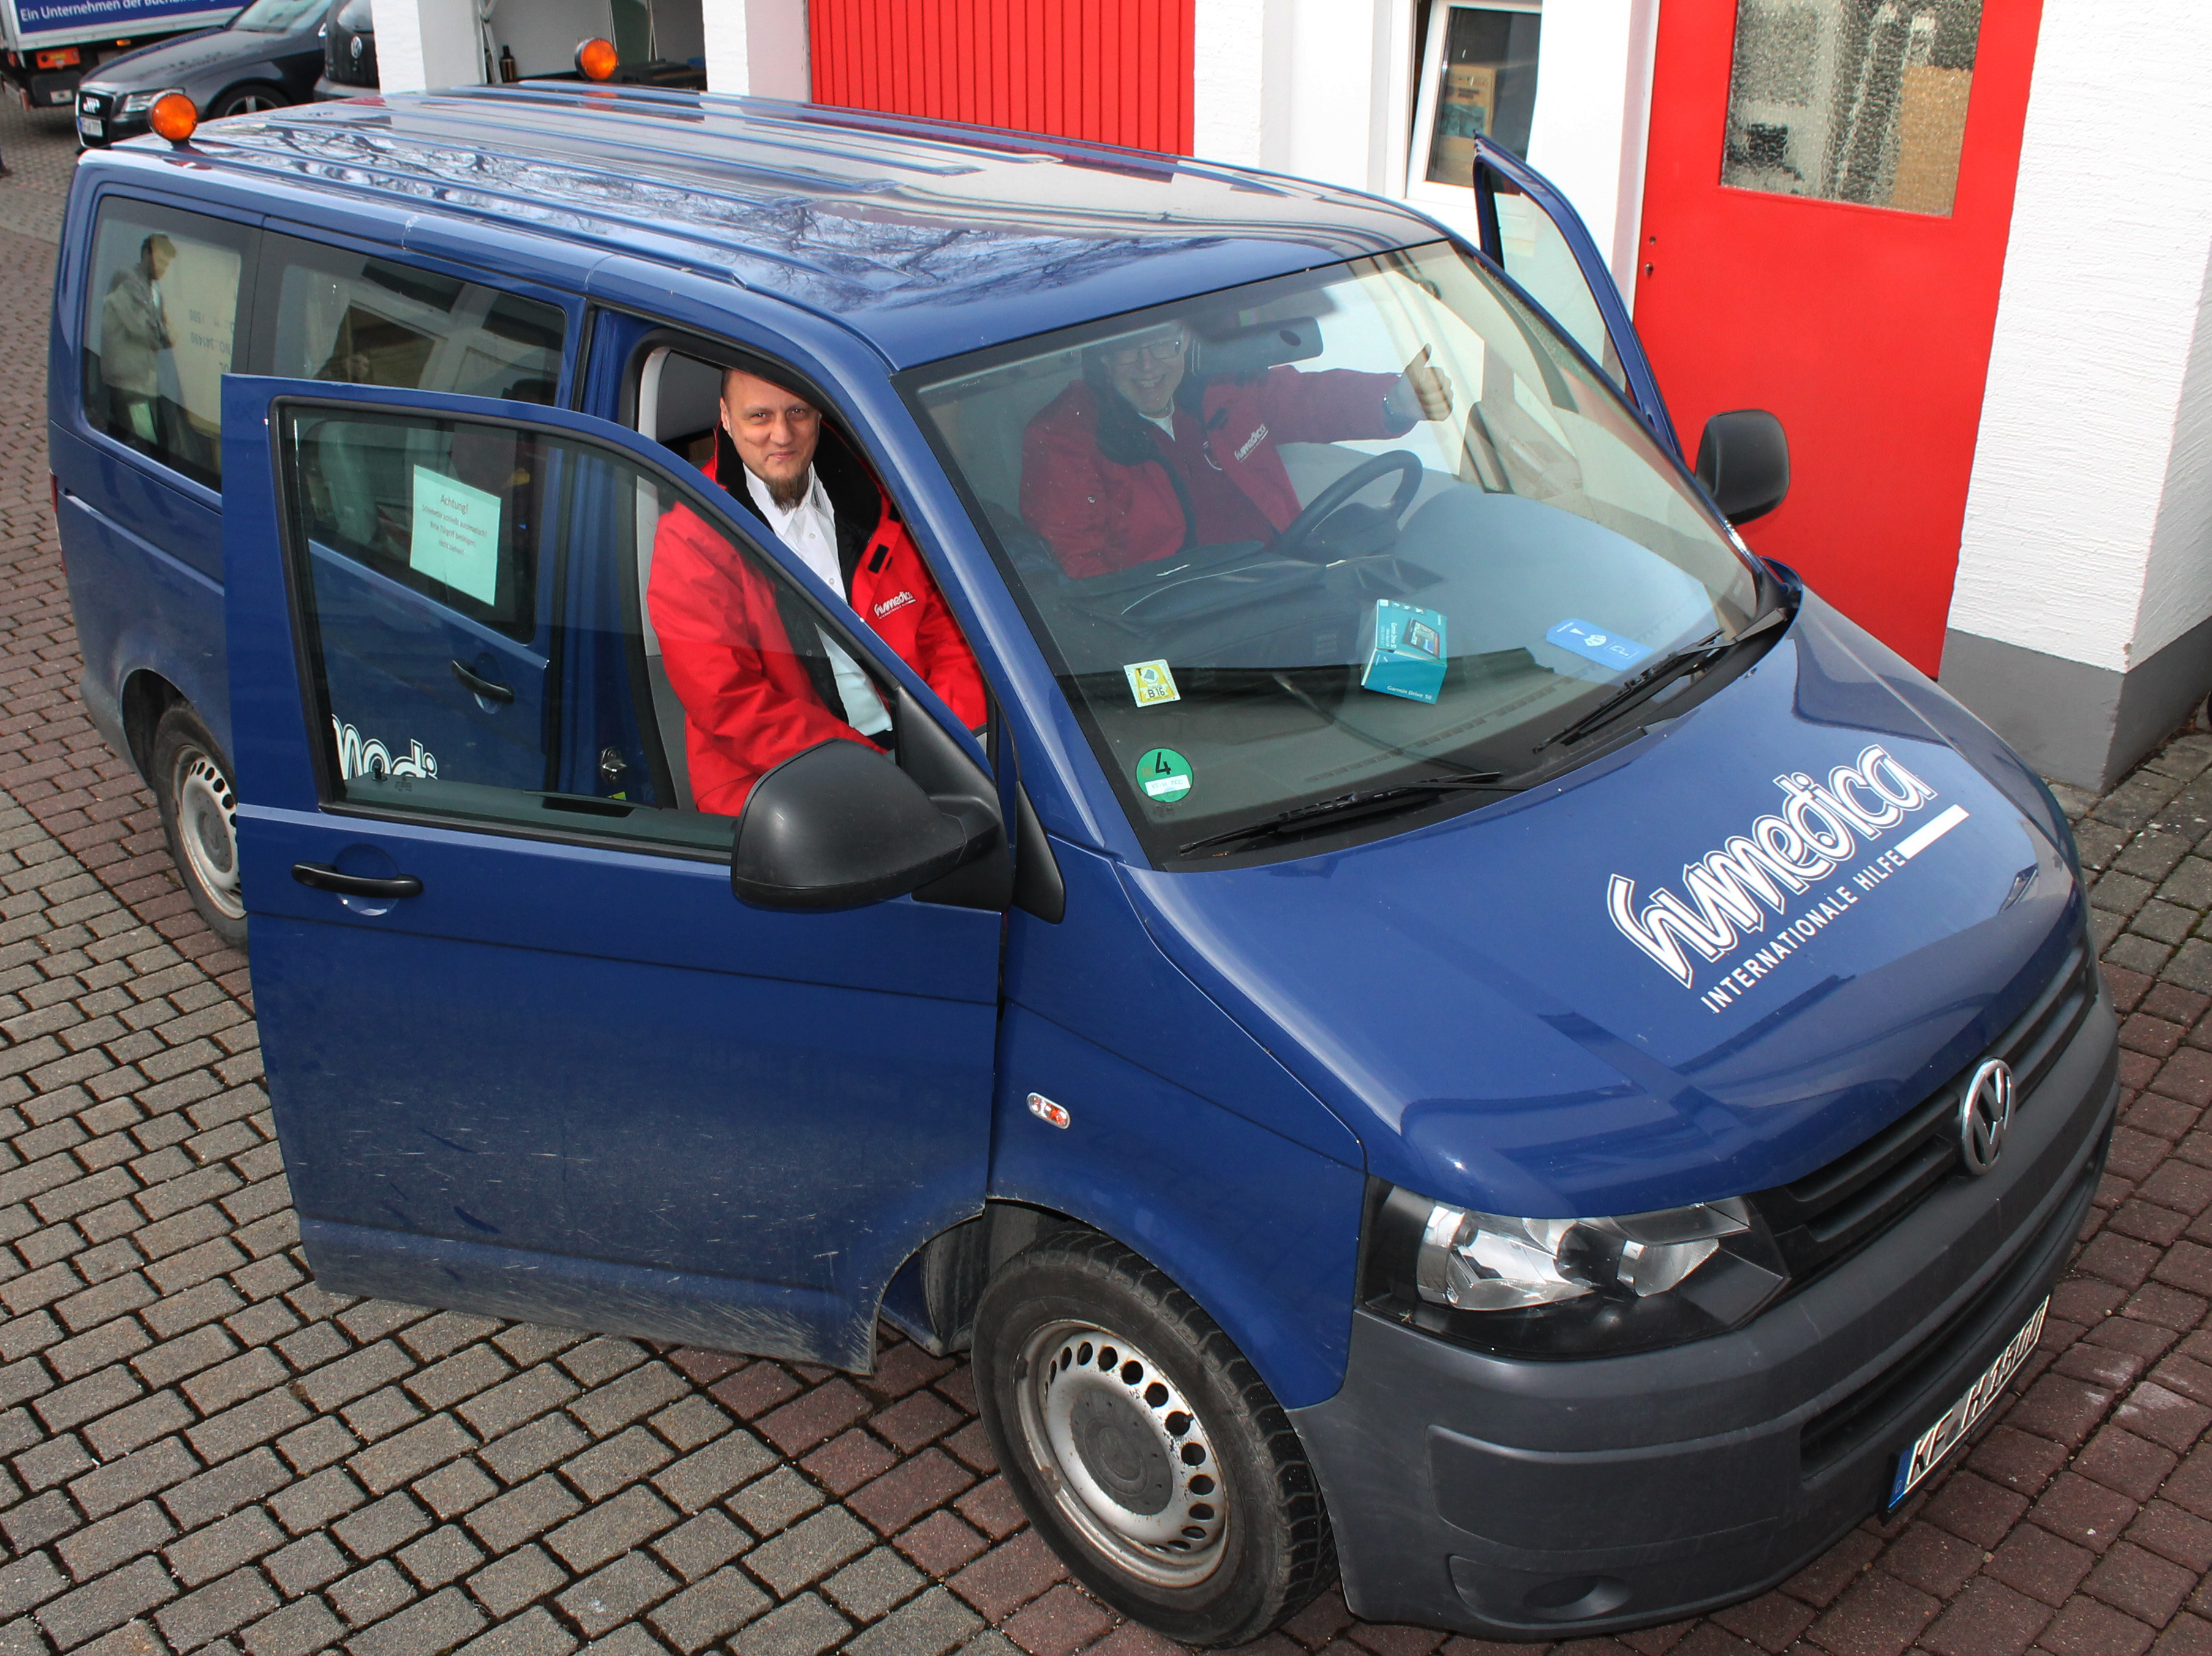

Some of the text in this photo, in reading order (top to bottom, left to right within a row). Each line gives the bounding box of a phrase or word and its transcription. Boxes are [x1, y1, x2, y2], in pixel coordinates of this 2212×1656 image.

[20, 7, 40, 22] Ein
[40, 0, 122, 20] Unternehmen
[440, 494, 468, 515] Achtung!
[1386, 685, 1408, 694] Garmin
[1408, 690, 1424, 698] Drive
[1155, 751, 1172, 775] 4
[1606, 743, 1938, 989] humedica
[1700, 849, 1906, 1014] INTERNATIONALE HILFE
